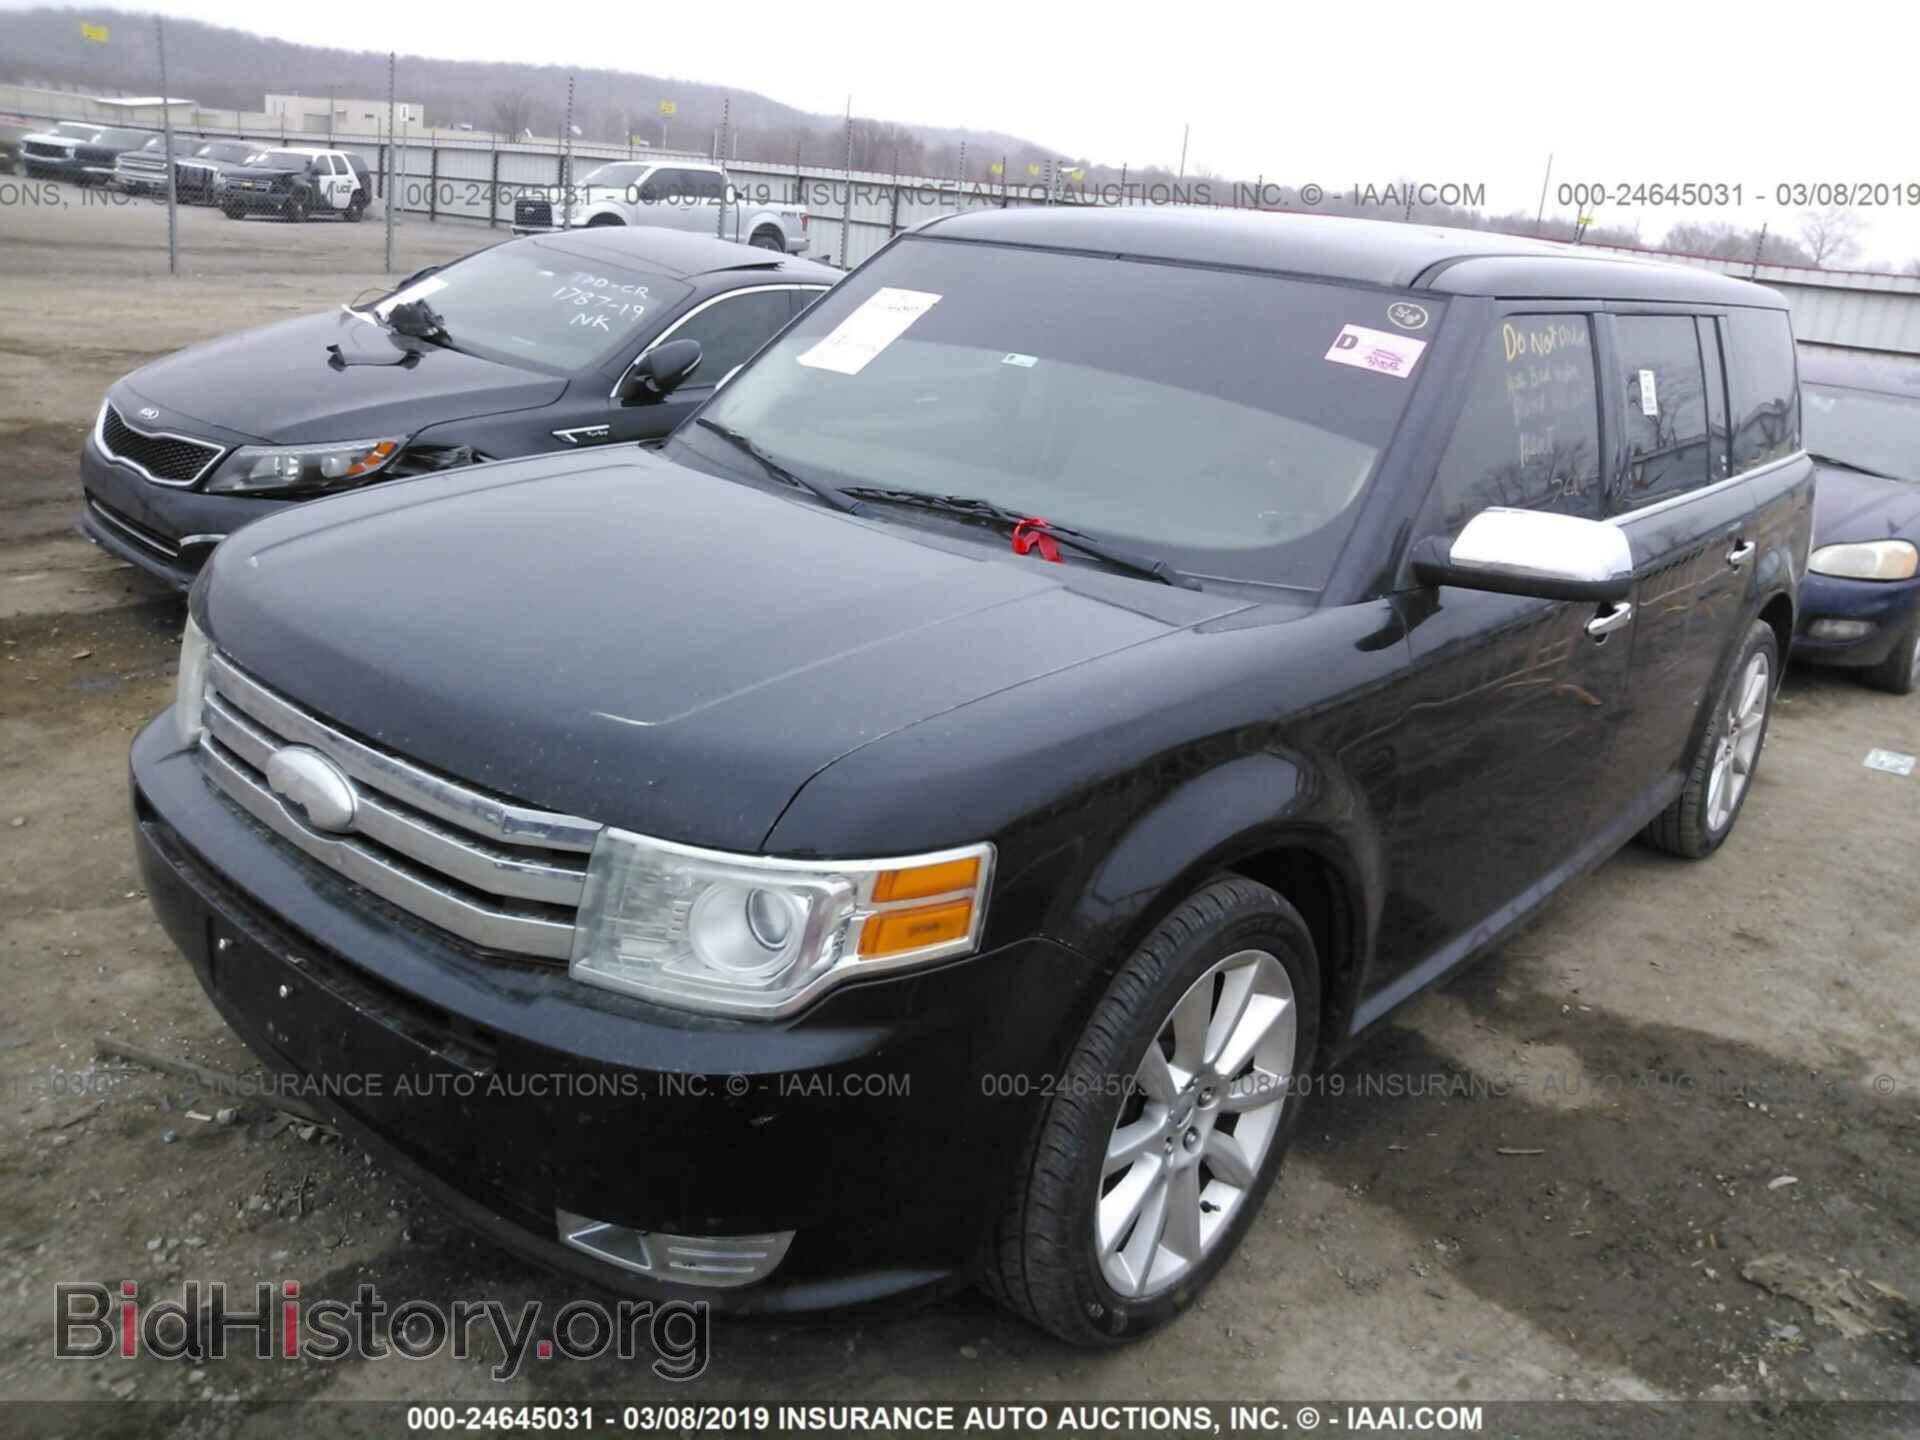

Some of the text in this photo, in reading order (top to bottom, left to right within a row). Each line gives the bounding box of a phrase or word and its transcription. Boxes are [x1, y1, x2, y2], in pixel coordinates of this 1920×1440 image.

[569, 312, 609, 332] NK
[1335, 333, 1359, 350] D
[1503, 323, 1526, 361] Do
